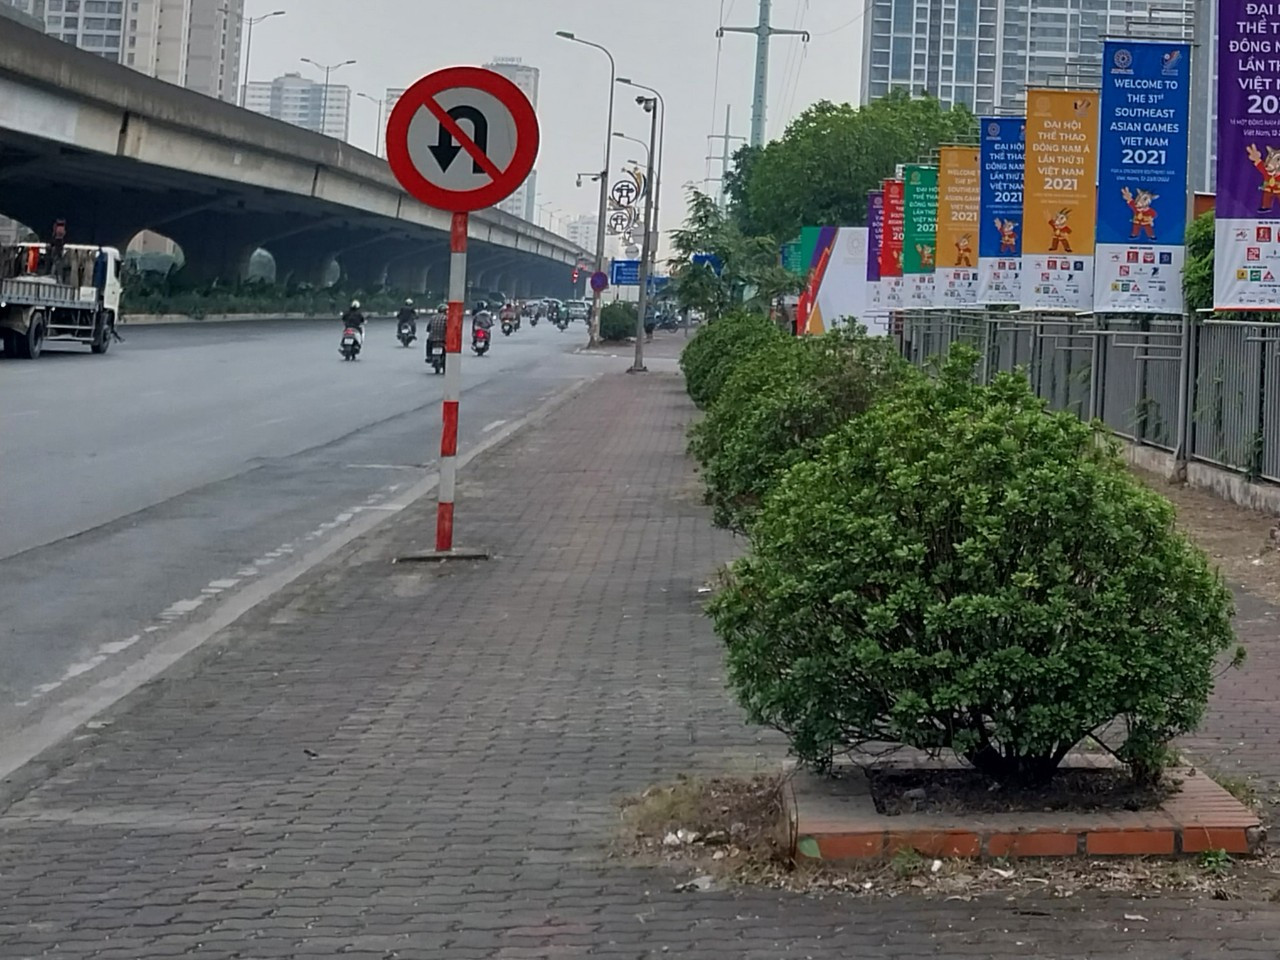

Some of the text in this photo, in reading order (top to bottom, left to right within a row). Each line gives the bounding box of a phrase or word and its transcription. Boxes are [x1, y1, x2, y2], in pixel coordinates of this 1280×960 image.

[1246, 3, 1273, 17] ĐẠI
[1236, 17, 1267, 34] THỂ
[1229, 38, 1271, 52] ĐÔNG
[1238, 55, 1265, 71] LẦN
[1114, 79, 1178, 89] WELCOME TO
[1238, 76, 1272, 93] VIỆT
[1127, 93, 1164, 104] THE 31st
[1115, 108, 1175, 118] SOUTHEAST
[1110, 122, 1179, 133] ASIAN GAMES
[1059, 133, 1086, 141] THAO
[1120, 136, 1168, 147] VIET NAM
[1061, 144, 1082, 153] NAM
[1076, 157, 1085, 165] 31
[1122, 149, 1166, 165] 2021
[1061, 167, 1085, 176] NAM
[1043, 178, 1078, 191] 2021
[994, 191, 1022, 203] 2021
[951, 211, 977, 221] 2021
[917, 223, 938, 232] 2021
